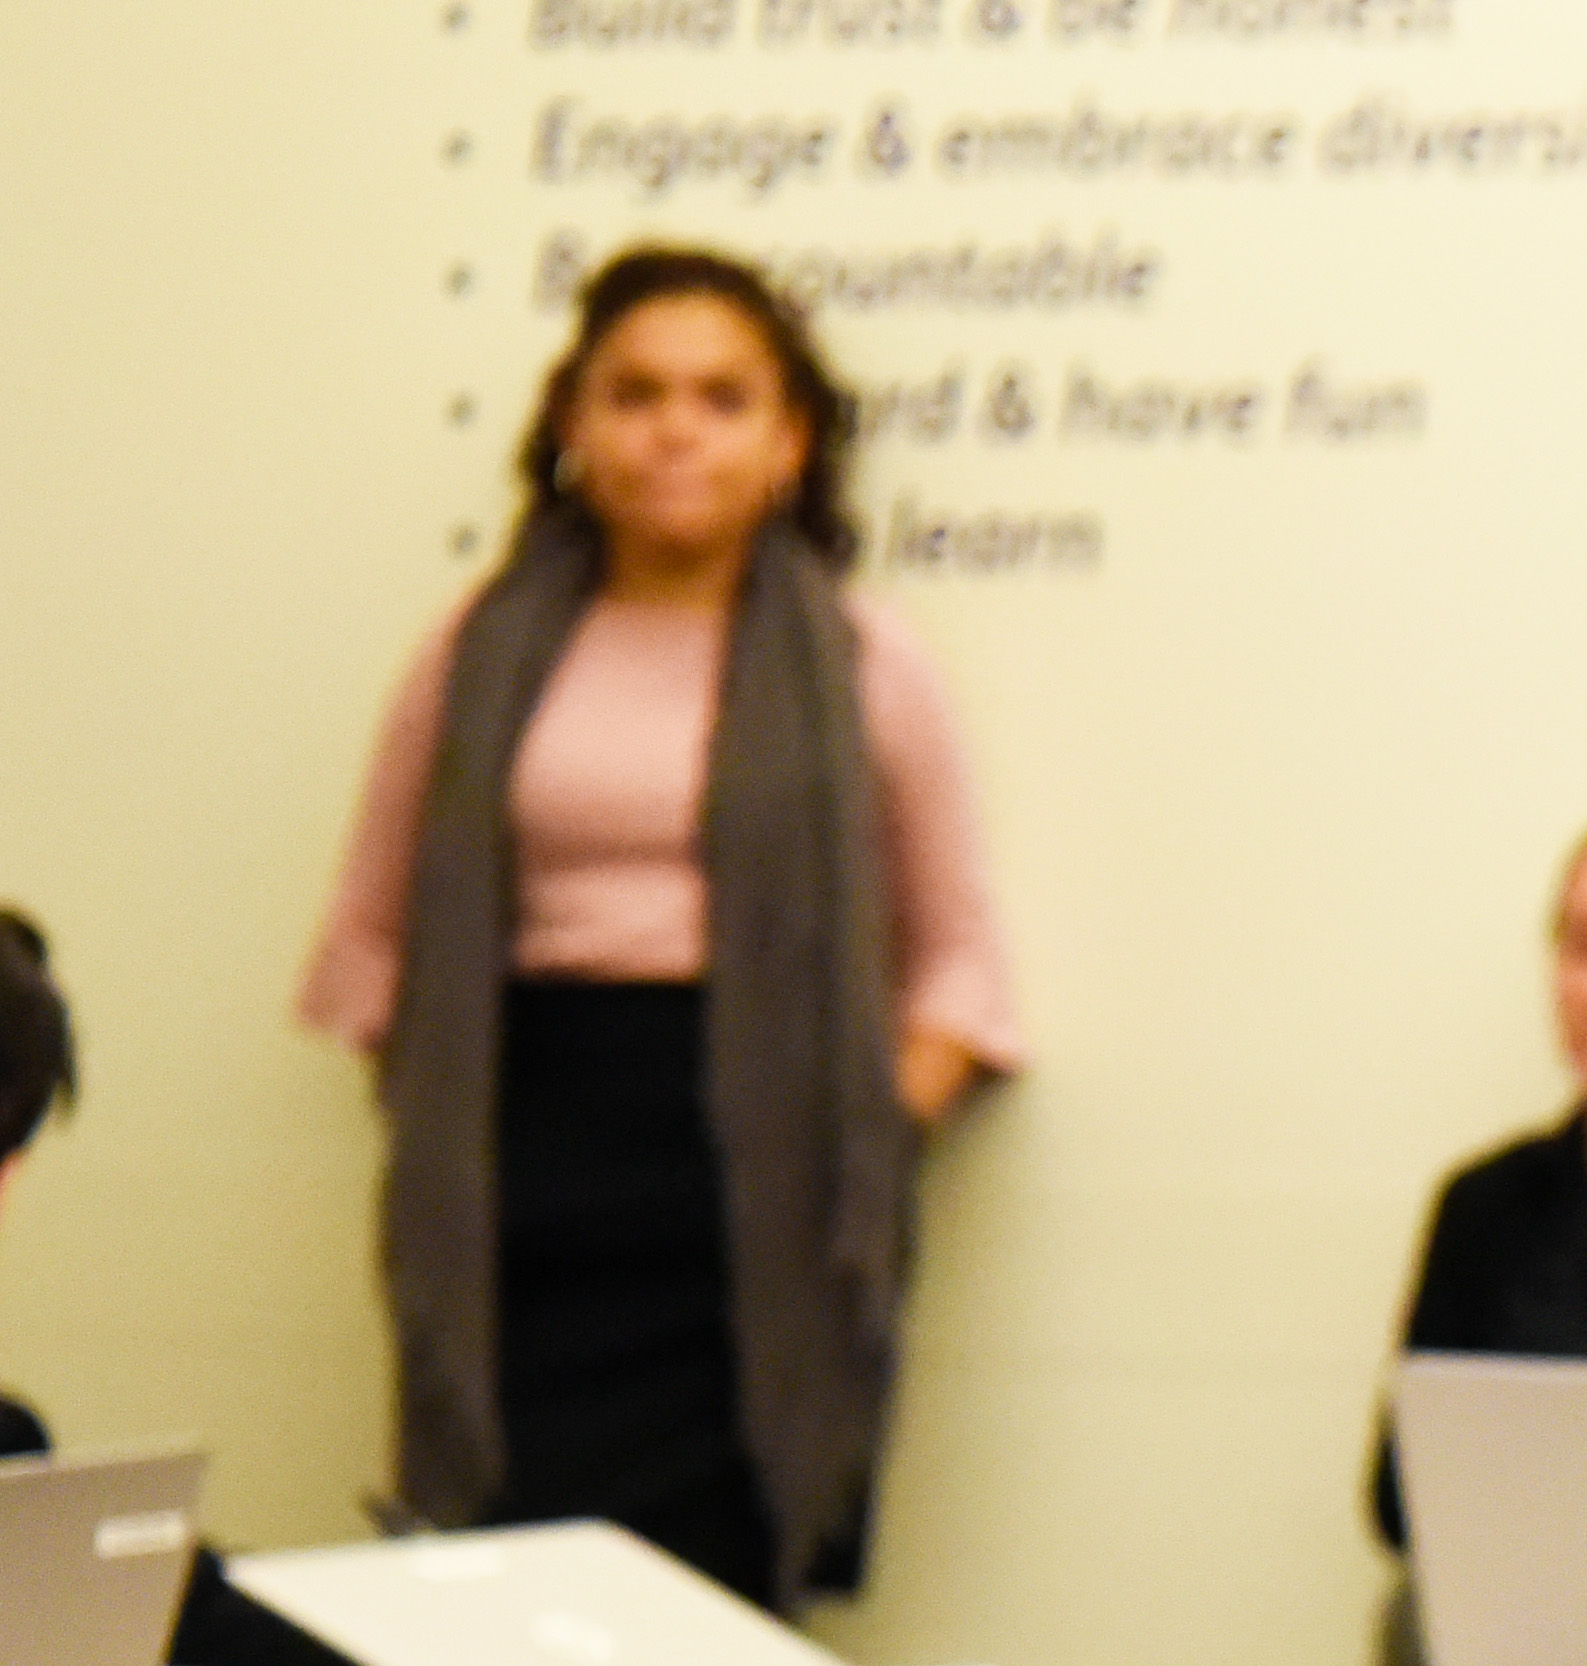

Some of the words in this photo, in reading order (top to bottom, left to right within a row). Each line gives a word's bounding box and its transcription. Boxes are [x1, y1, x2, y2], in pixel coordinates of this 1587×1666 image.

[533, 97, 831, 196] Engage
[860, 97, 914, 176] &
[938, 96, 1293, 175] embrace
[982, 362, 1036, 442] &
[1060, 358, 1262, 442] have
[1285, 355, 1428, 440] fun
[885, 498, 1104, 570] learn
